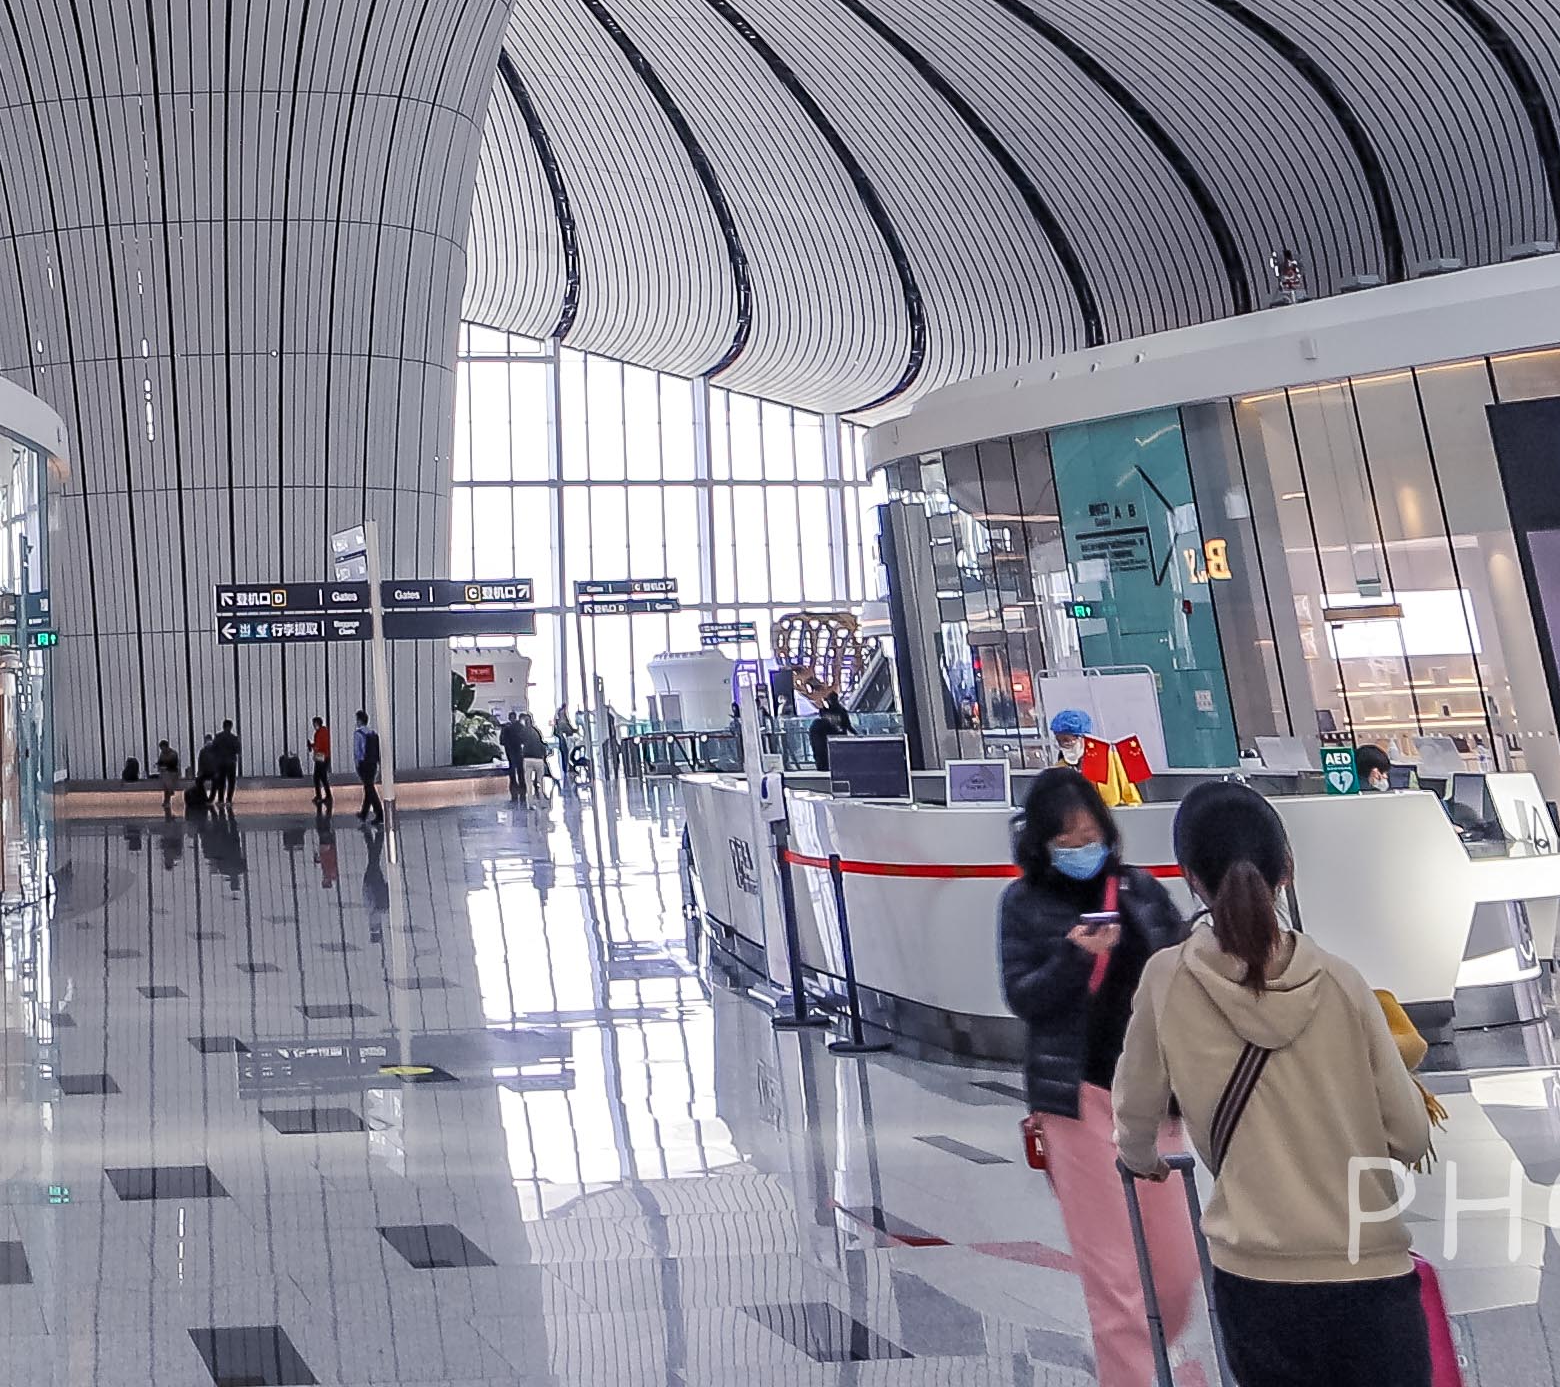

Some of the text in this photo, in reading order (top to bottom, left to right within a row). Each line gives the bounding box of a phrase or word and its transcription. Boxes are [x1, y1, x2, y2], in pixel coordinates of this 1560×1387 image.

[236, 591, 271, 606] 登机口
[1325, 752, 1351, 765] AED
